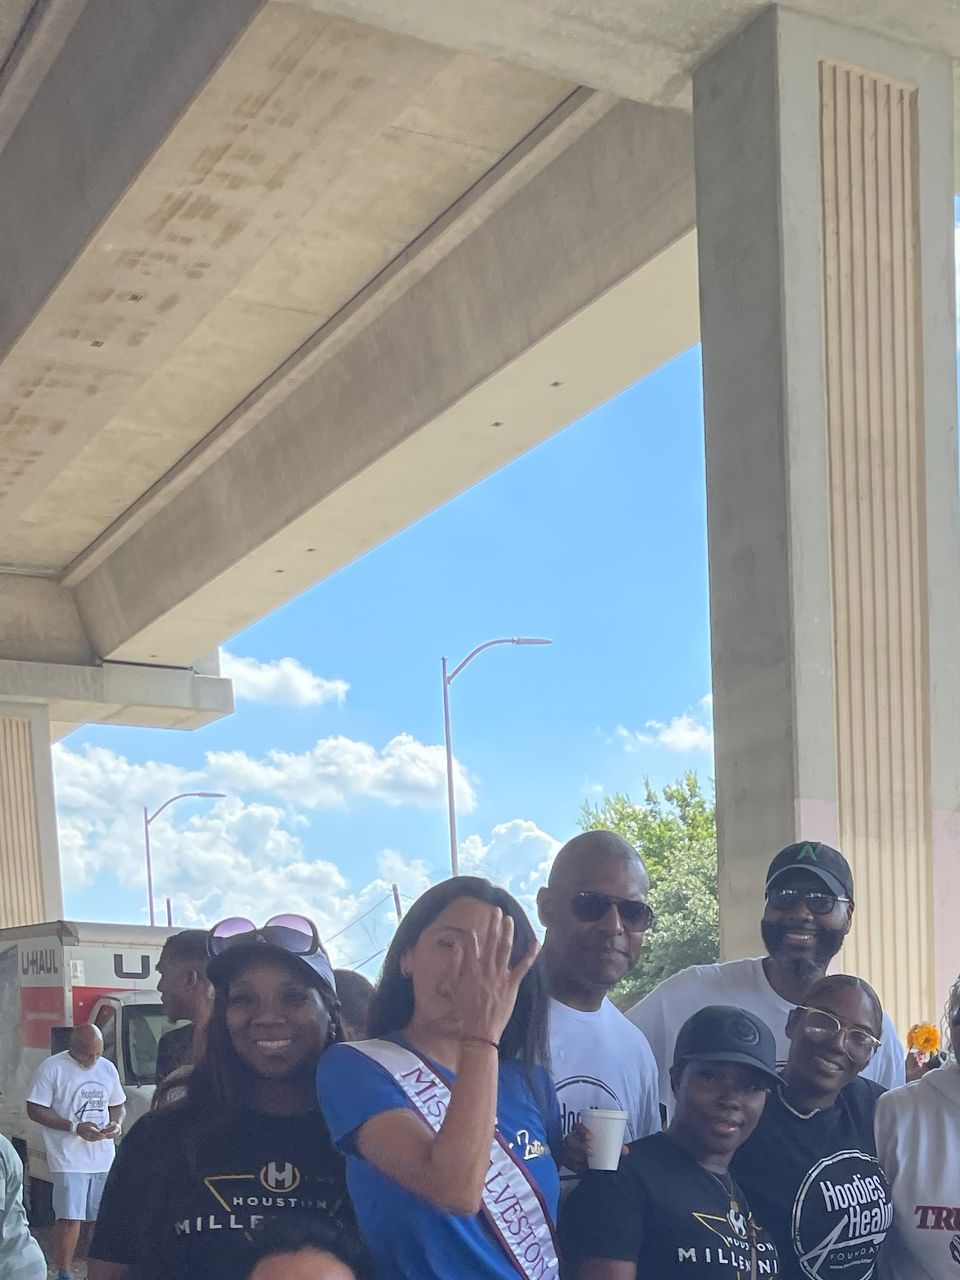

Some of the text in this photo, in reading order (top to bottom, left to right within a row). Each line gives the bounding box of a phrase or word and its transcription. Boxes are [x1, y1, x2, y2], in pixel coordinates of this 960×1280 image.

[21, 949, 59, 976] U-HAUL
[401, 1067, 448, 1125] MIS
[819, 1173, 886, 1212] Hoodies
